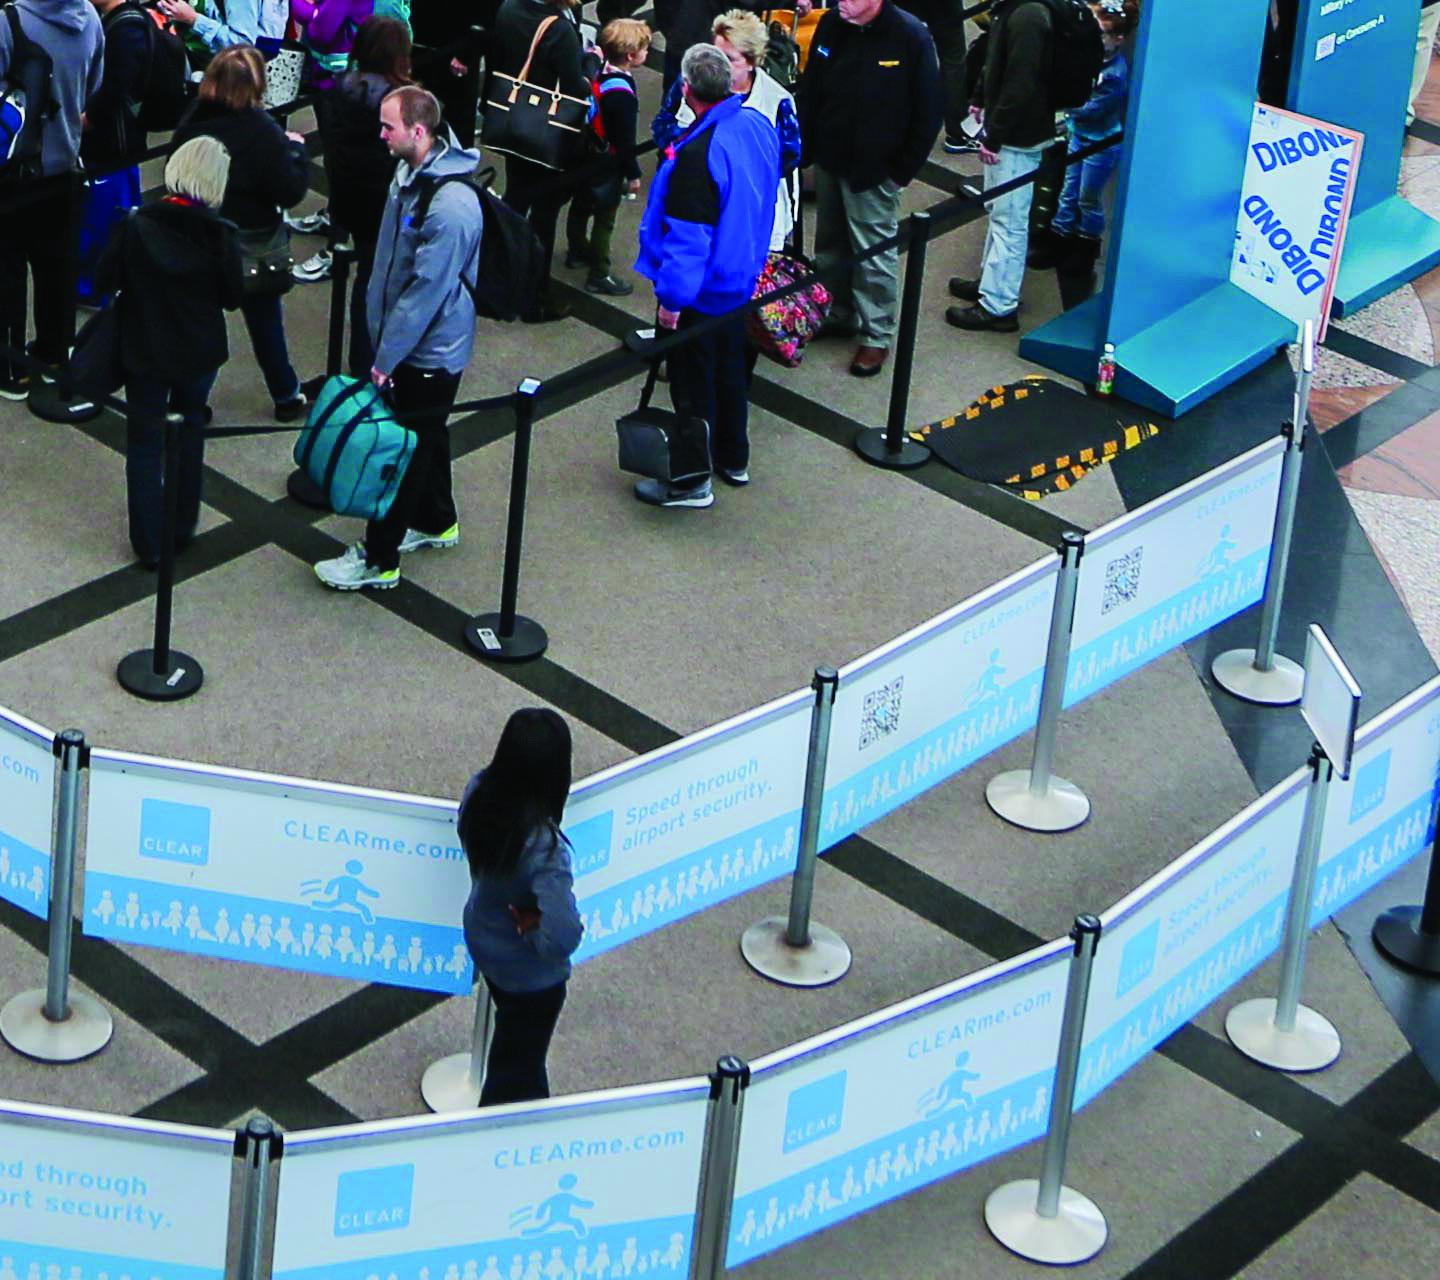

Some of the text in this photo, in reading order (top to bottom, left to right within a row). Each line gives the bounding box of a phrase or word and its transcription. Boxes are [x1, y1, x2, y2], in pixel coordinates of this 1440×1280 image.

[1336, 33, 1347, 43] on
[1346, 19, 1378, 42] Concourse
[1243, 195, 1326, 296] DIBOND
[622, 779, 774, 851] airport security.
[624, 758, 759, 828] Speed through
[142, 834, 206, 859] CLEAR
[283, 817, 464, 864] CLEARme.com
[906, 988, 1053, 1060] CLEARme.com
[495, 1127, 688, 1173] CLEARme.com
[785, 1111, 838, 1146] CLEAR
[38, 1159, 150, 1199] through
[42, 1188, 175, 1231] security.
[337, 1206, 406, 1231] CLEAR
